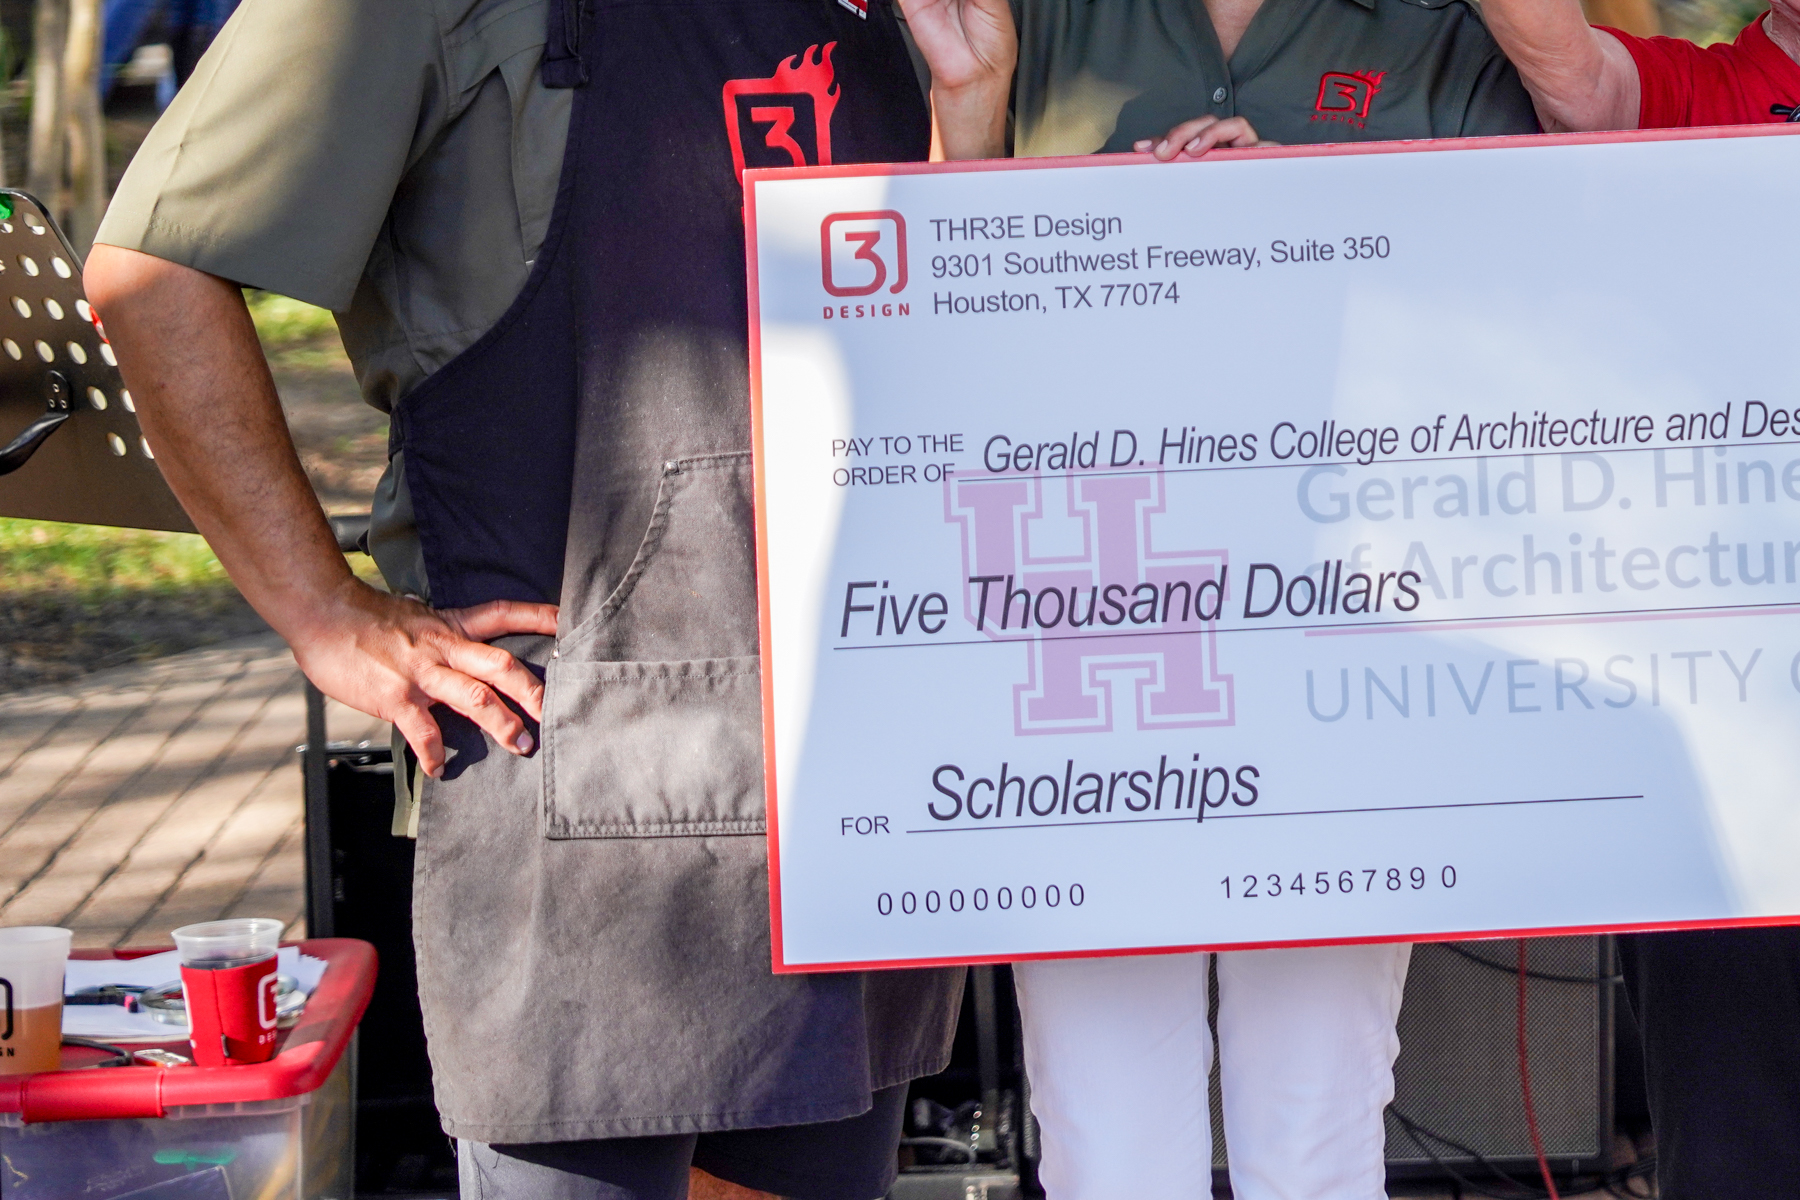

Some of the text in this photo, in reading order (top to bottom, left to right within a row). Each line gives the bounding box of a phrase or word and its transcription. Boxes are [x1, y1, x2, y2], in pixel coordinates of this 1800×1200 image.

[1310, 114, 1365, 129] DESIGN
[930, 213, 1121, 241] THR3E Design
[932, 236, 1390, 278] 9301 Southwest Freeway, Suite 350
[823, 302, 911, 320] DESIGN
[934, 282, 1180, 314] Houston, TX 77074
[833, 434, 963, 457] PAY TO THE
[984, 431, 1099, 473] Gerald
[1110, 430, 1144, 467] D.
[1159, 426, 1257, 465] Hines
[1270, 416, 1400, 467] College
[1411, 415, 1446, 453] of
[1449, 409, 1654, 452] Architecture
[1666, 402, 1731, 441] and
[833, 463, 955, 486] ORDER OF
[1296, 455, 1537, 524] Gerald
[1560, 450, 1632, 512] D.
[1301, 542, 1373, 606] of
[841, 560, 1421, 637] Five Thousand Dollars
[1305, 648, 1763, 723] UNIVERSITY
[928, 753, 1260, 823] Scholarships
[842, 816, 890, 835] FOR
